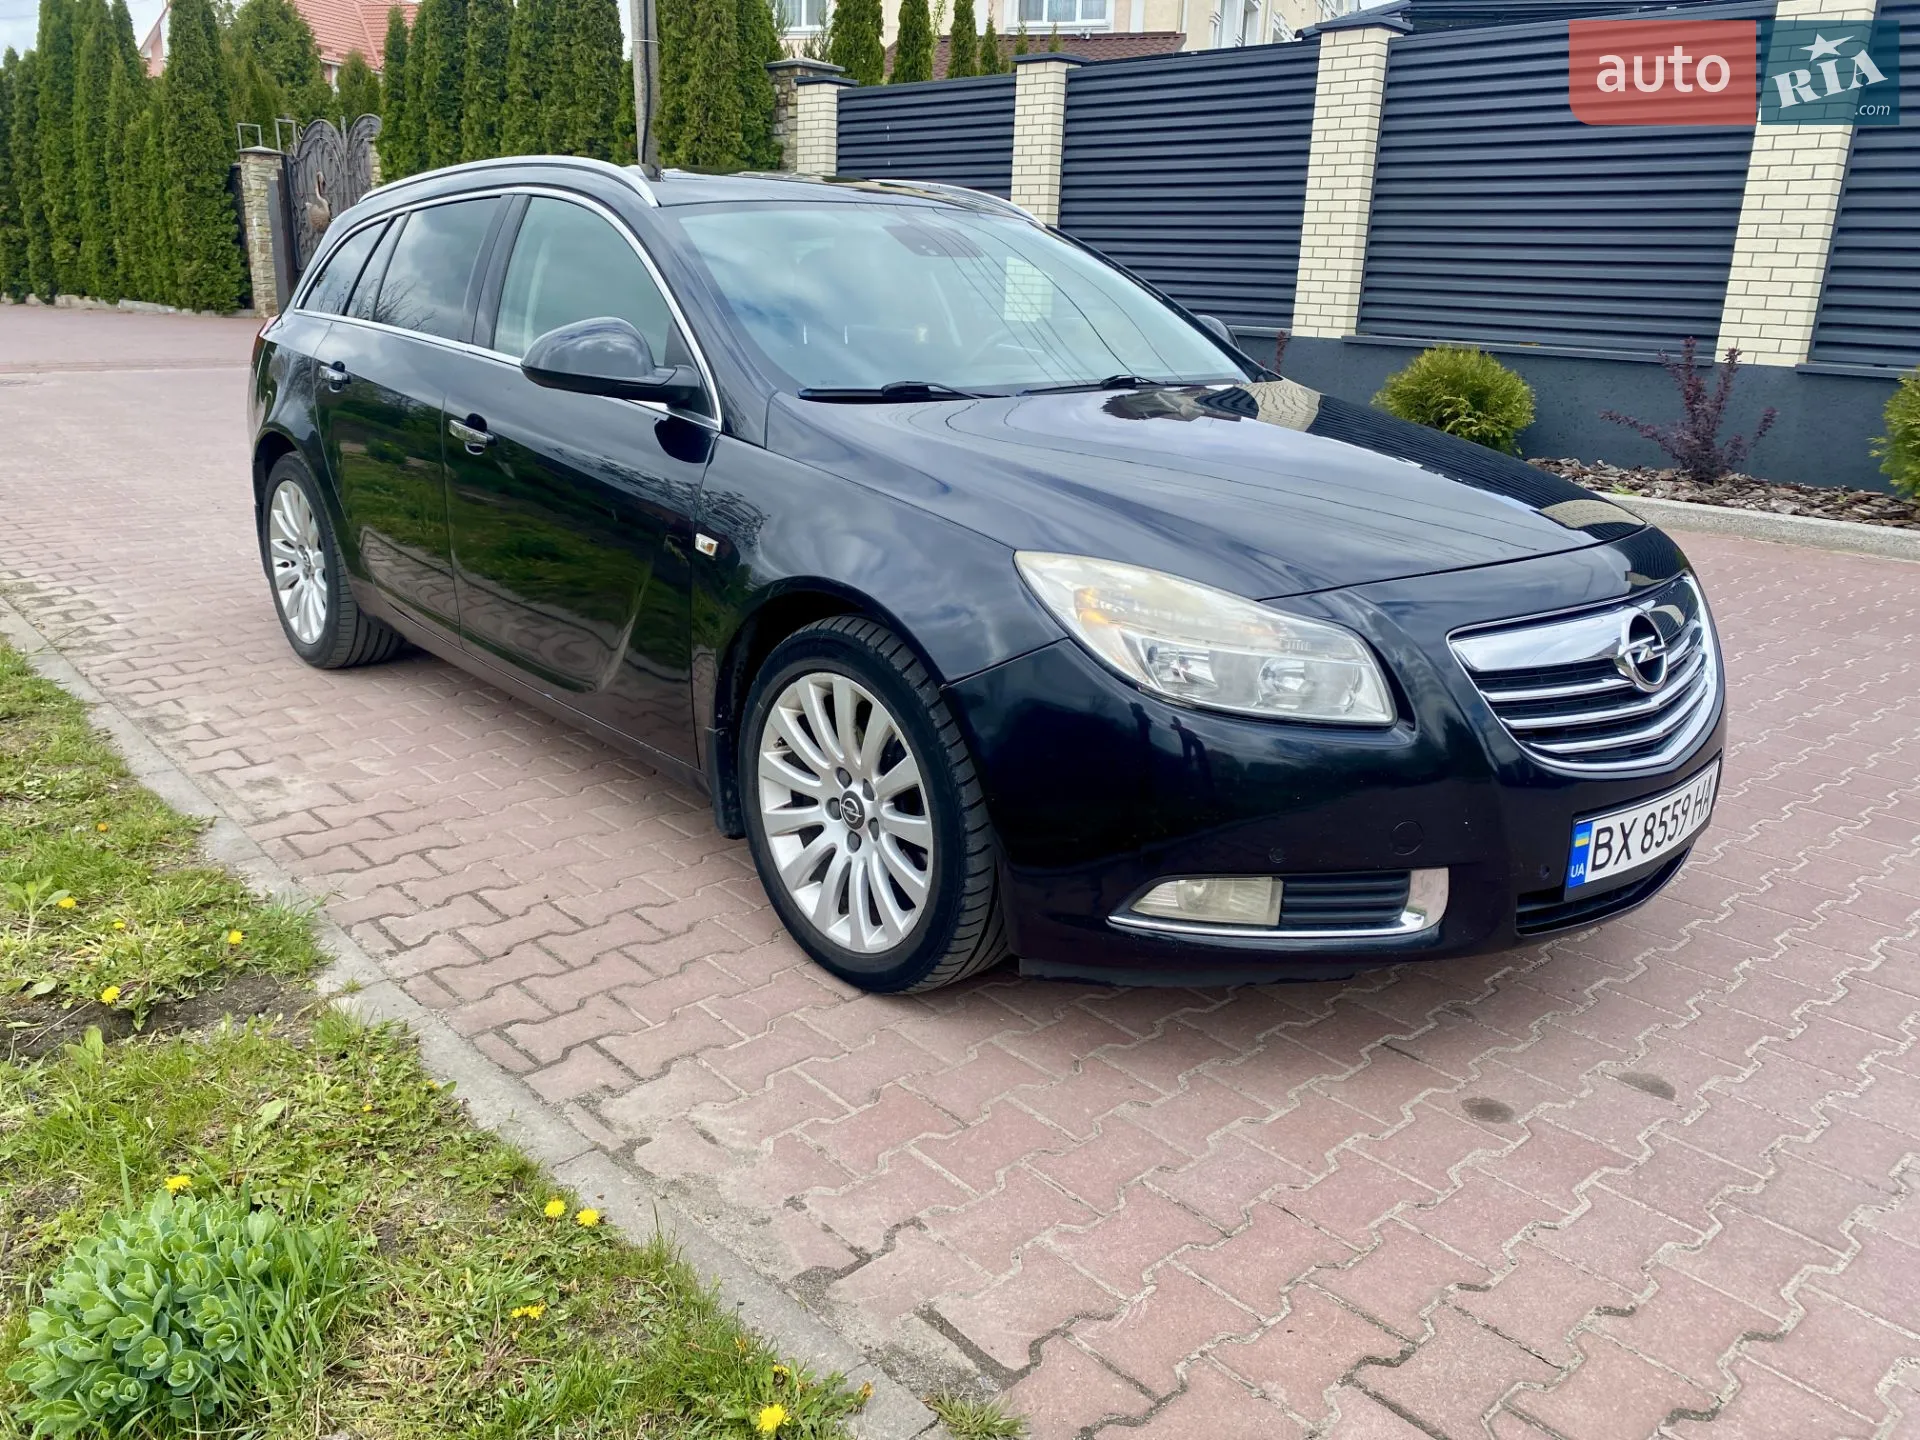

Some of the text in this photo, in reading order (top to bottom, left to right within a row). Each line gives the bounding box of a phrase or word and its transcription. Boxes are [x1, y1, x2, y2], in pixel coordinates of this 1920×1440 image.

[1590, 817, 1638, 872] BX
[1640, 793, 1691, 854] 8559
[1570, 862, 1585, 878] UA
